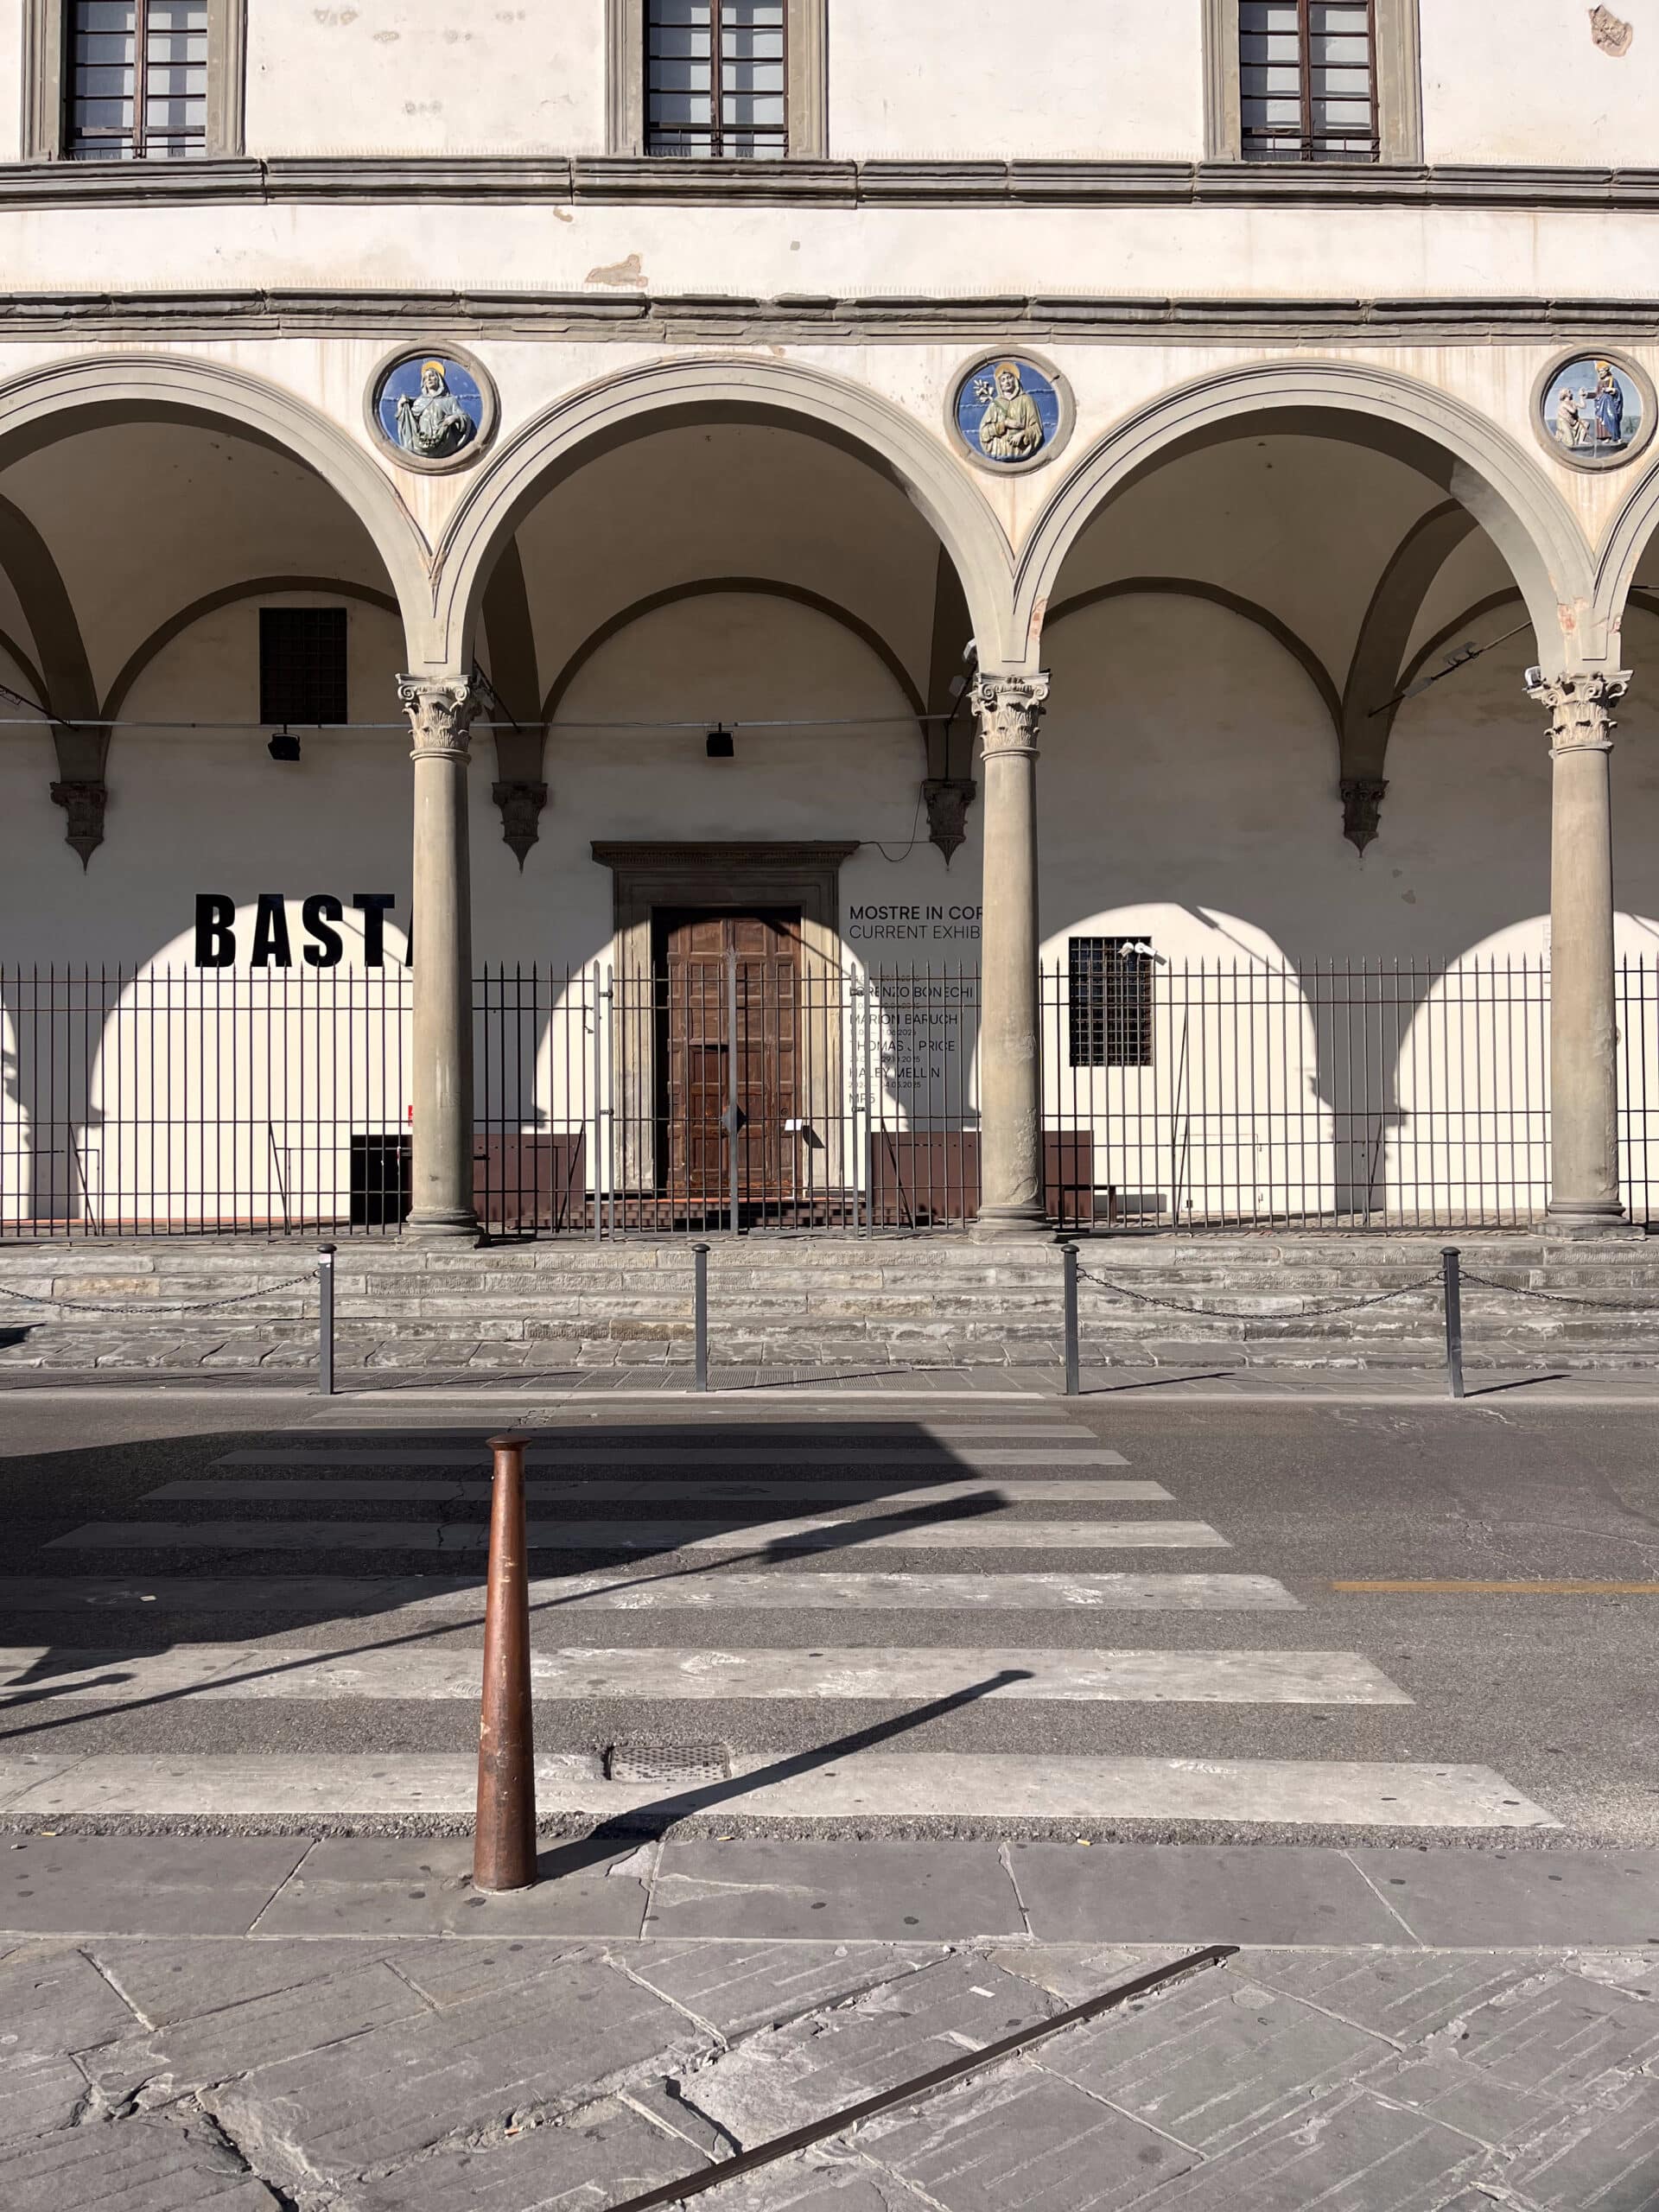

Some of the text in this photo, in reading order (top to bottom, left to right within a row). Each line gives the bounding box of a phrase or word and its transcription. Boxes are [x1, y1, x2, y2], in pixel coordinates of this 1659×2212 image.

[849, 906, 920, 921] MOSTRE
[925, 906, 943, 920] IN
[195, 893, 414, 968] BAST
[849, 925, 981, 939] CURRENT EXHIB
[905, 1014, 957, 1025] BARUCH
[894, 1067, 940, 1078] MELLN
